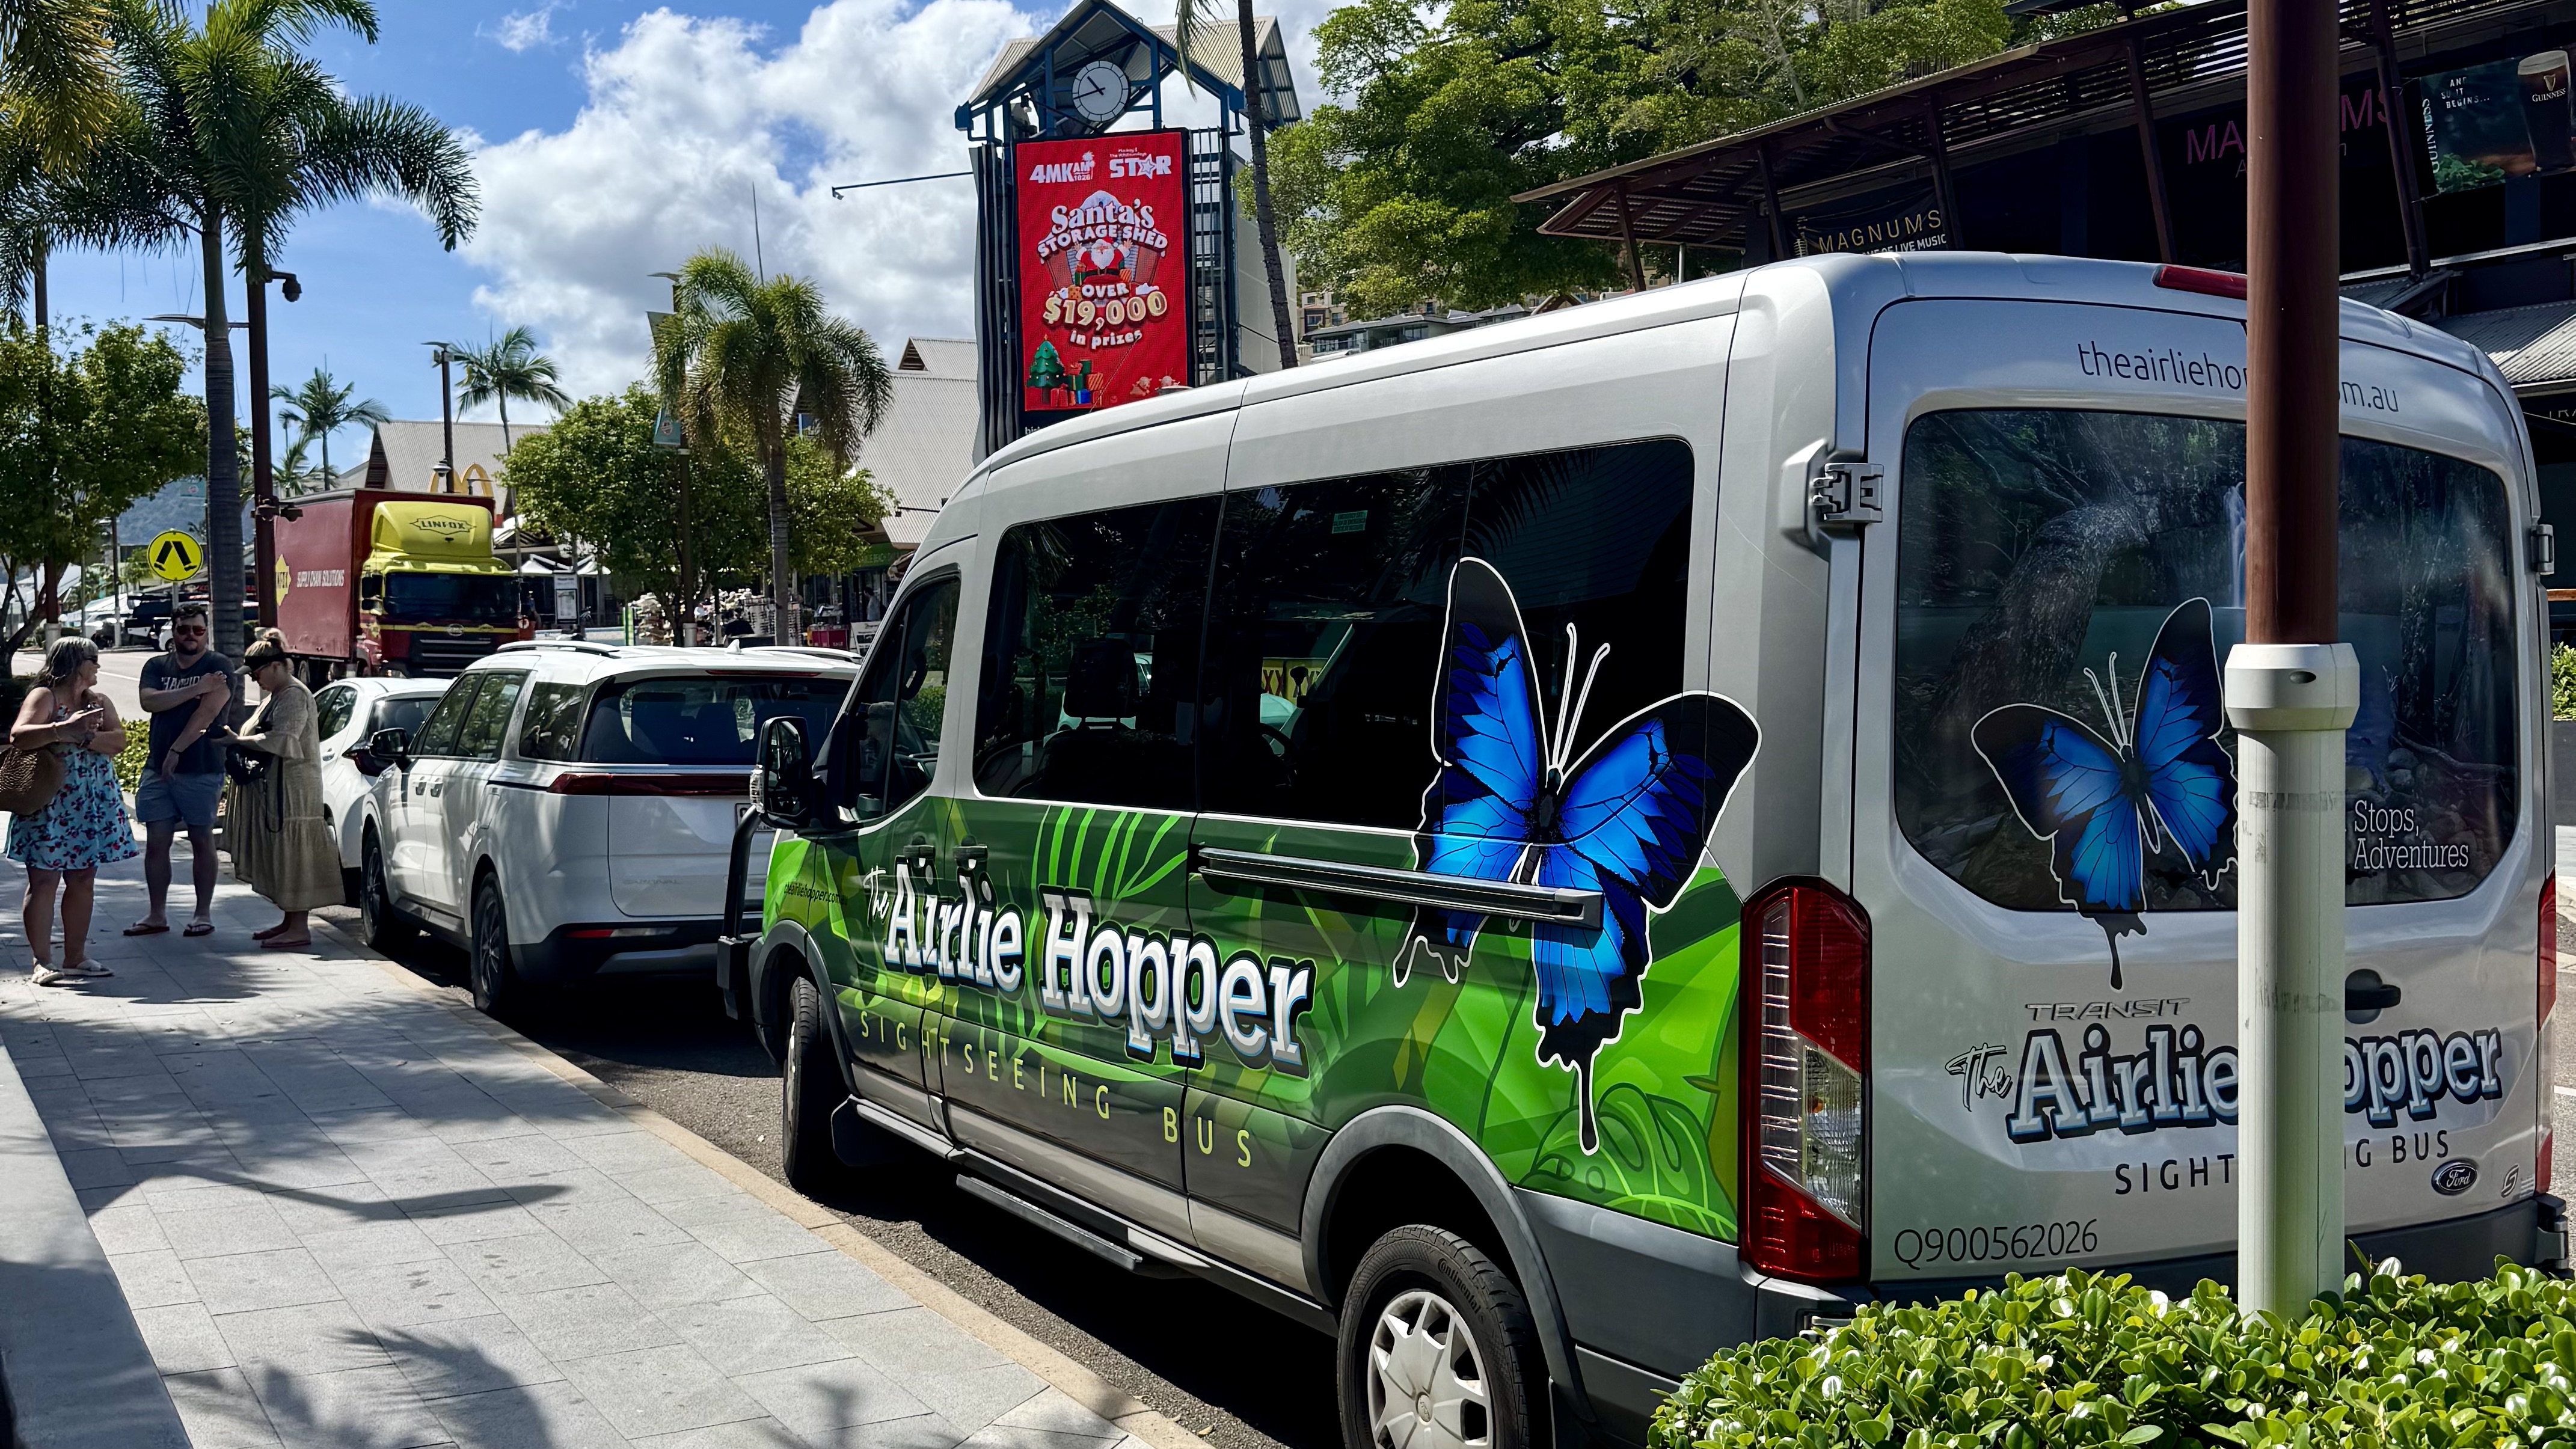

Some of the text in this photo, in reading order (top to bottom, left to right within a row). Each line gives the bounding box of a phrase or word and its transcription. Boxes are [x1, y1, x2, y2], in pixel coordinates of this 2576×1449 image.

[2532, 88, 2566, 102] GUINNESS
[2422, 98, 2440, 174] GUINNESS
[1051, 198, 1155, 234] Santa's
[1818, 210, 1942, 254] MAGNUMS
[1037, 224, 1168, 257] STORAGE SHED
[1895, 241, 1916, 252] LIVE
[1917, 234, 1947, 250] MUSIC
[1082, 283, 1130, 298] OVER
[1043, 290, 1168, 331] $19,000
[1070, 329, 1142, 350] in prizes
[2354, 800, 2419, 839] Stops,
[2354, 838, 2469, 869] Adventures
[863, 858, 1314, 1073] The Airlie Hopper
[2025, 997, 2191, 1021] TRANSIT
[860, 1009, 1251, 1168] SIGHTSEEING BUS
[1945, 1043, 2013, 1112] The
[2392, 1129, 2449, 1163] BUS
[2446, 1168, 2471, 1187] Ford
[1894, 1219, 2098, 1270] Q900562026
[1438, 1257, 1482, 1314] Continental
